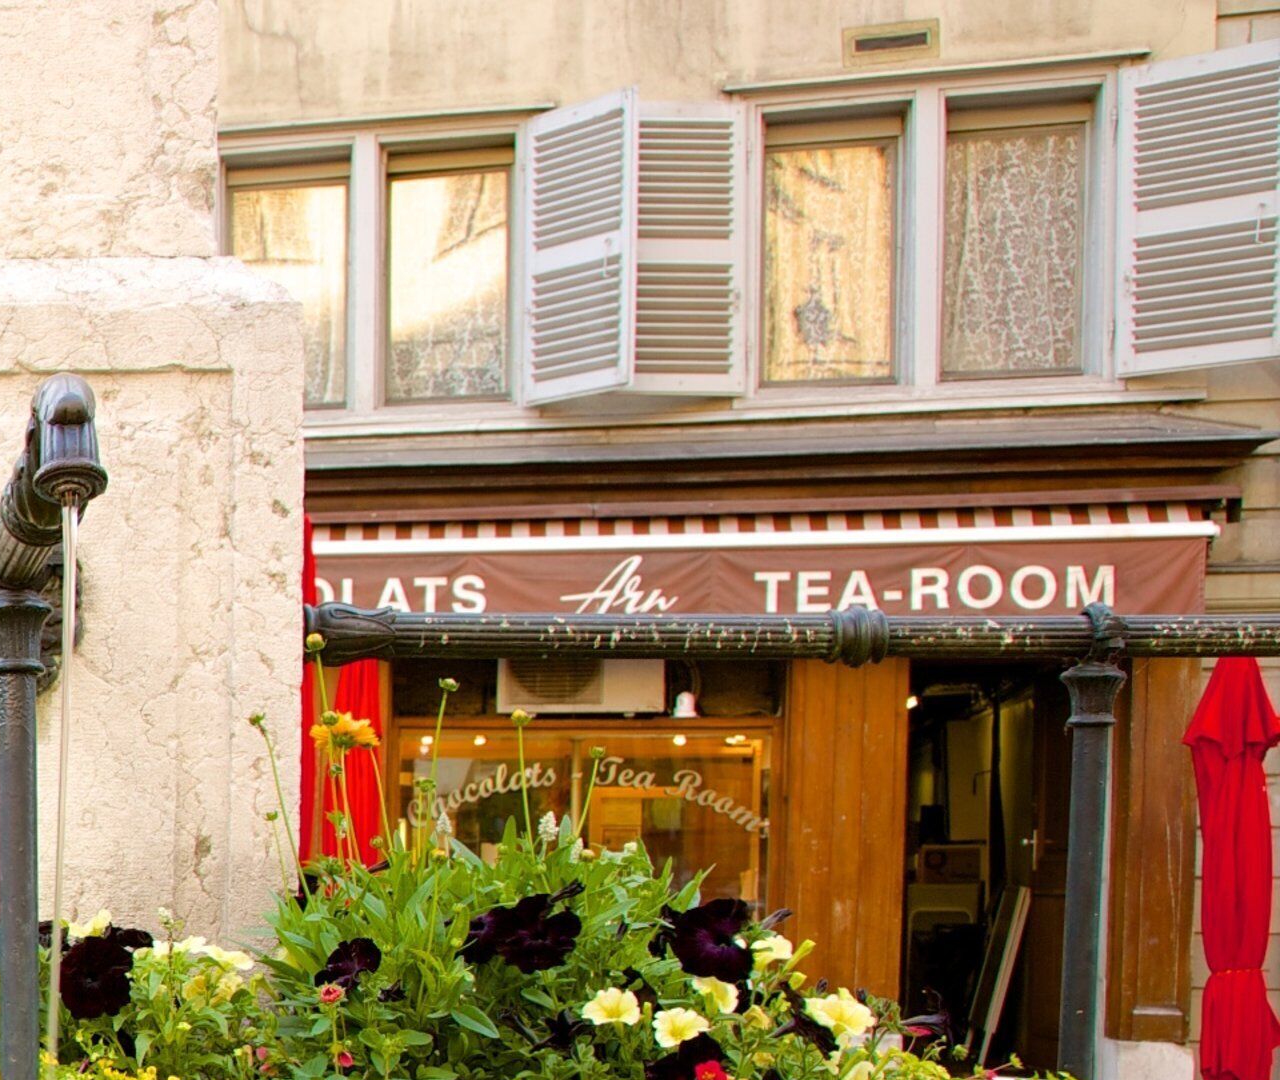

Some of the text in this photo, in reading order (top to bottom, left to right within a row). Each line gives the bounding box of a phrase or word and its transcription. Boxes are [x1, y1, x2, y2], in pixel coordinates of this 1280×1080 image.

[560, 554, 678, 614] Arn
[754, 564, 1115, 613] TEA-ROOM
[406, 762, 557, 829] Chocolats
[595, 755, 656, 790] Tea
[666, 768, 766, 834] Room
